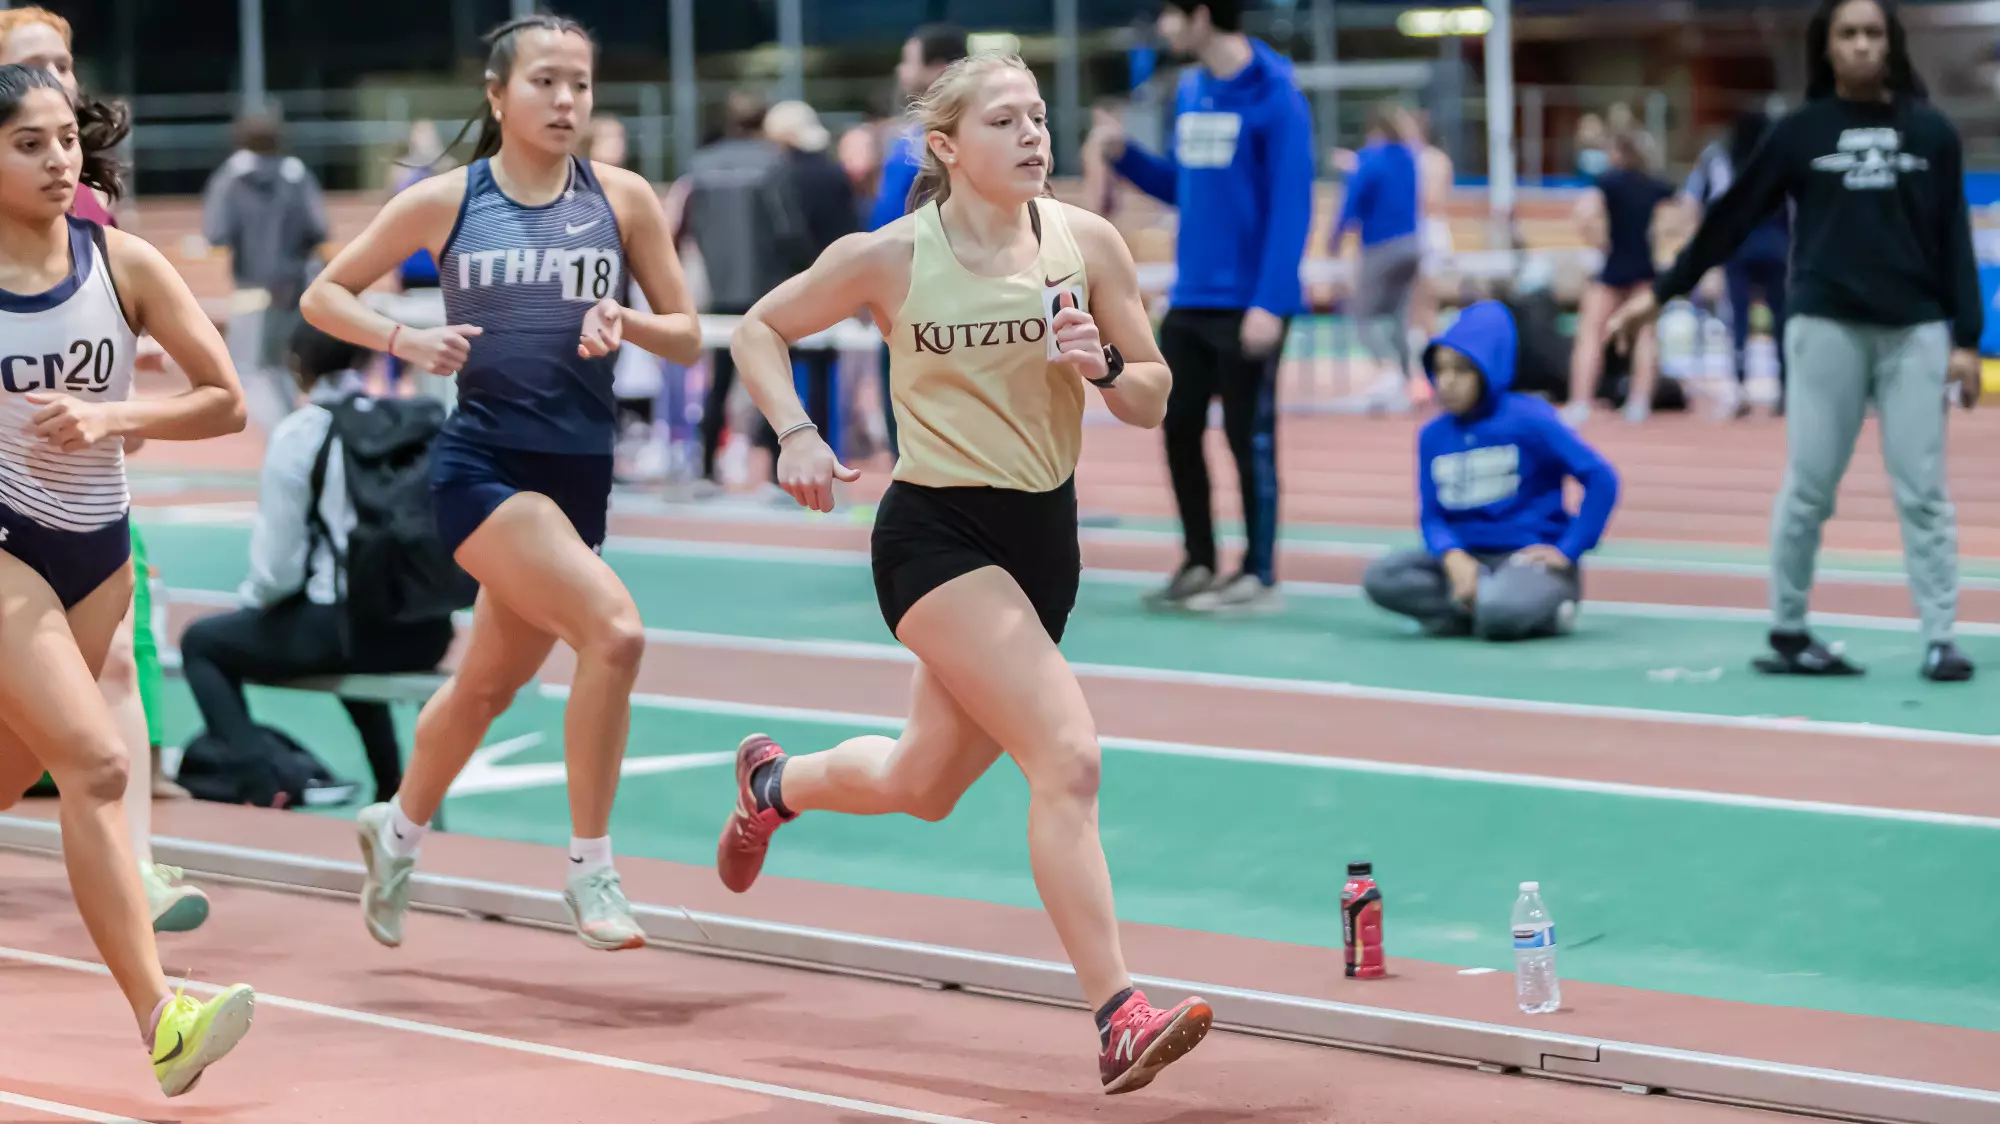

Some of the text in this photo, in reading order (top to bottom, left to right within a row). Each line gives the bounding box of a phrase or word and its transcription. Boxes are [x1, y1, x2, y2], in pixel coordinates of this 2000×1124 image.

[458, 248, 619, 289] ITHA
[570, 255, 611, 299] 18
[910, 317, 1047, 355] KUTZTO
[64, 338, 114, 384] 20
